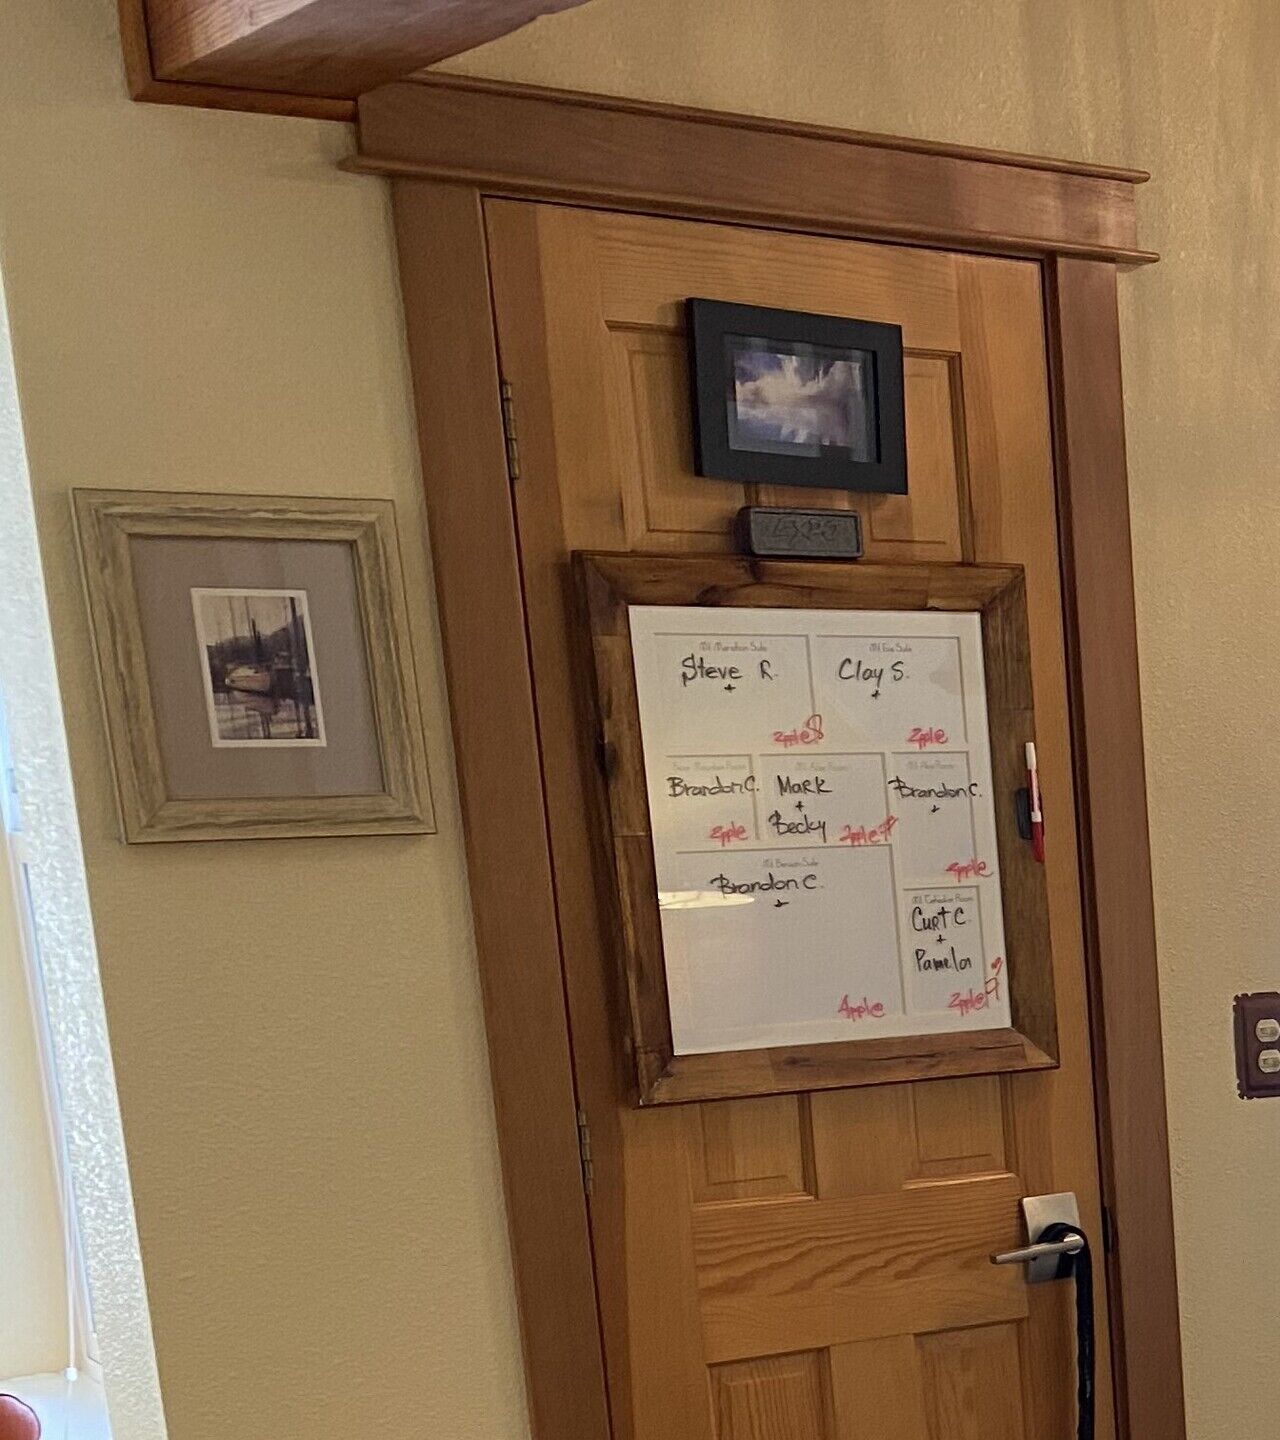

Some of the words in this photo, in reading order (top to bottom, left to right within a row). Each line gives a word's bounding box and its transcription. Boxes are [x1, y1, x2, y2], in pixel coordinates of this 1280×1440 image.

[682, 653, 743, 687] Steve
[838, 658, 883, 690] Clay
[666, 777, 744, 798] Brandon
[888, 775, 967, 800] Brandon
[768, 810, 828, 843] Becky
[710, 872, 800, 895] Brandon
[915, 948, 973, 973] Pamela
